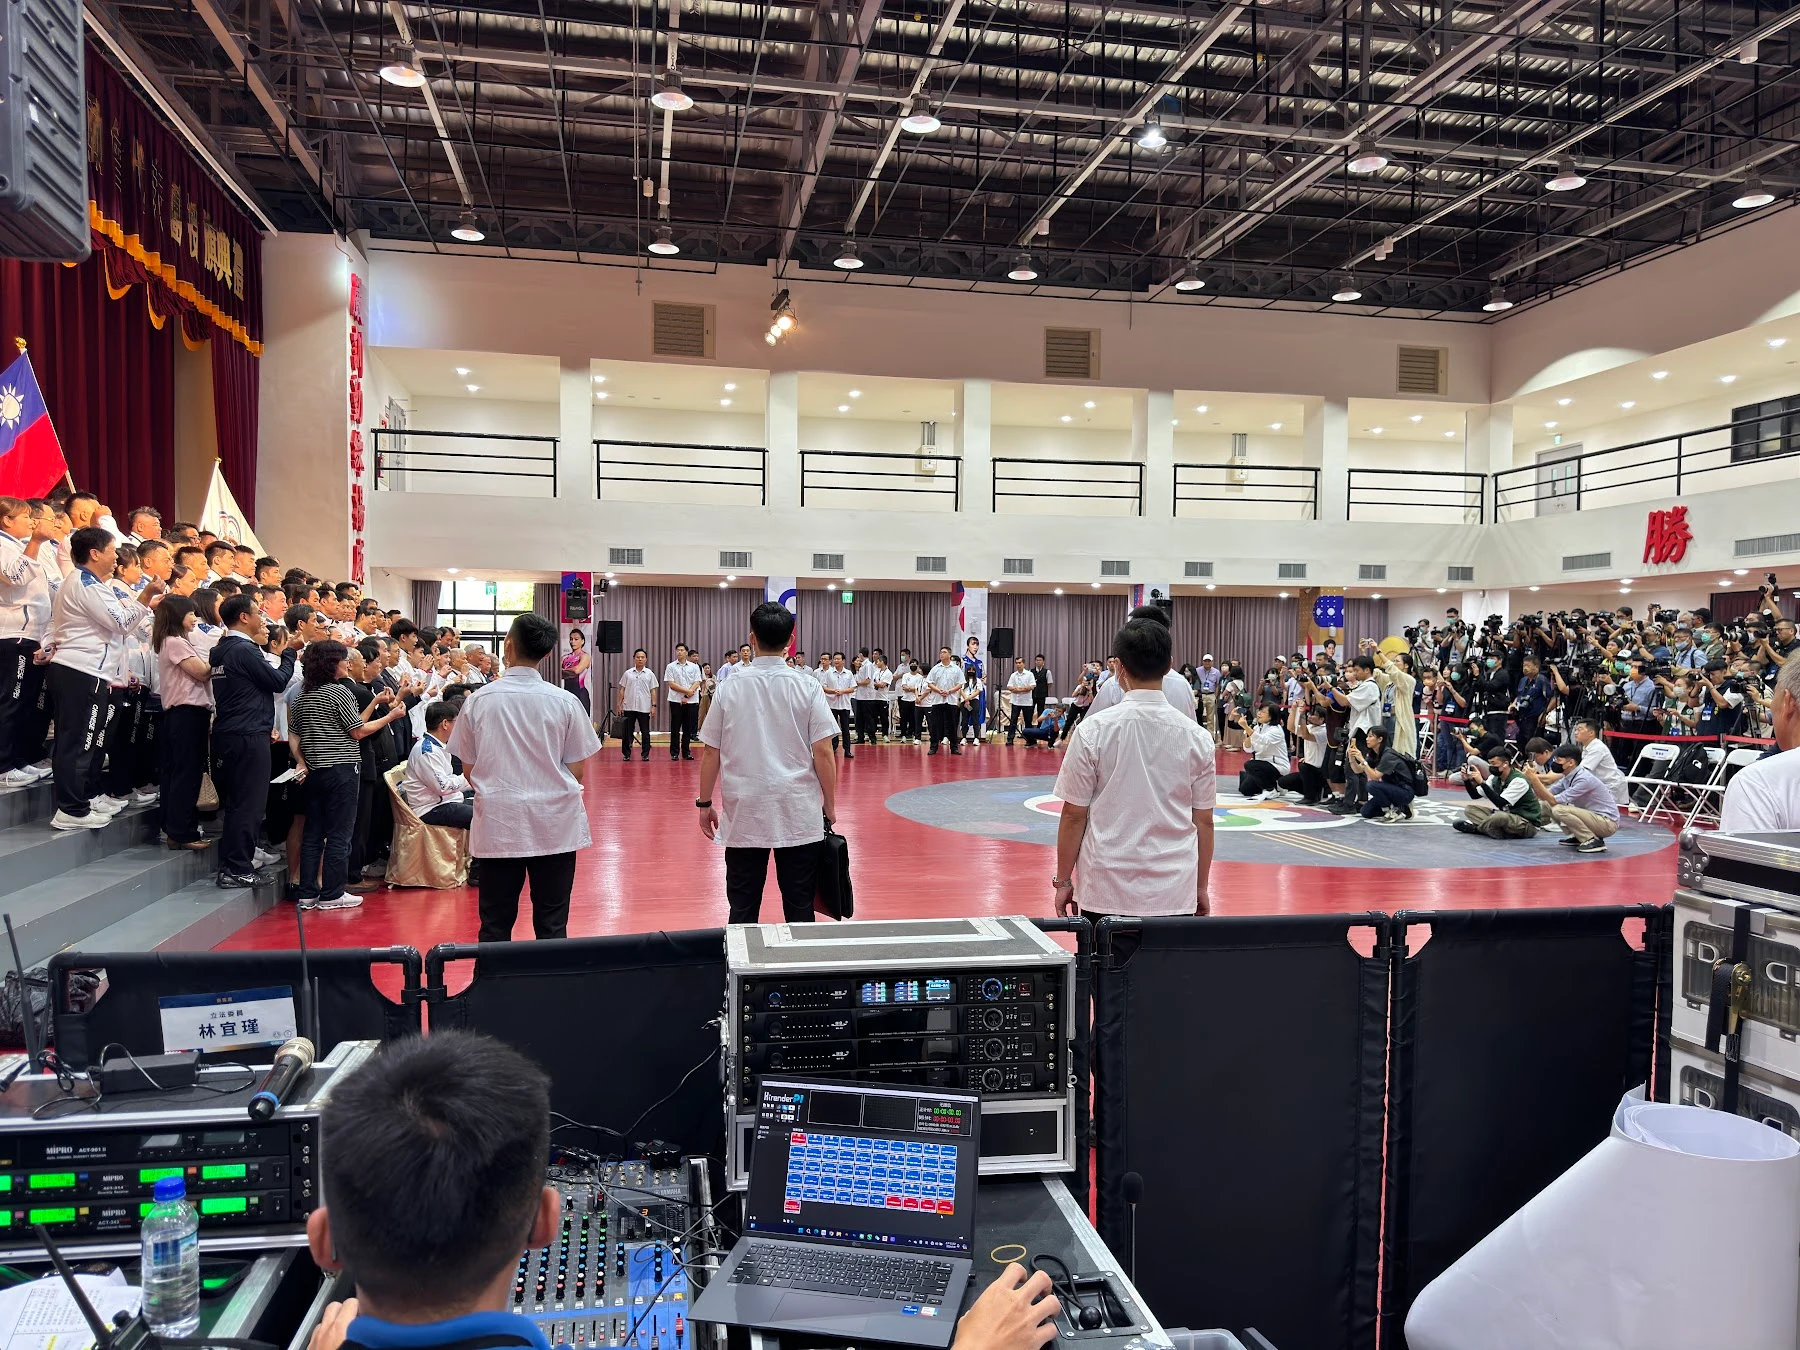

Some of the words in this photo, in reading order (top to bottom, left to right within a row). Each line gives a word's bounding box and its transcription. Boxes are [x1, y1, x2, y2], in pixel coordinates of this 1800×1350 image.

[1643, 506, 1693, 564] 勝
[17, 654, 26, 680] CHINESE
[88, 704, 98, 731] CHINESE
[84, 732, 94, 752] TAIPEI
[210, 1010, 244, 1019] 立法委員
[198, 1018, 260, 1039] 林宜瑾
